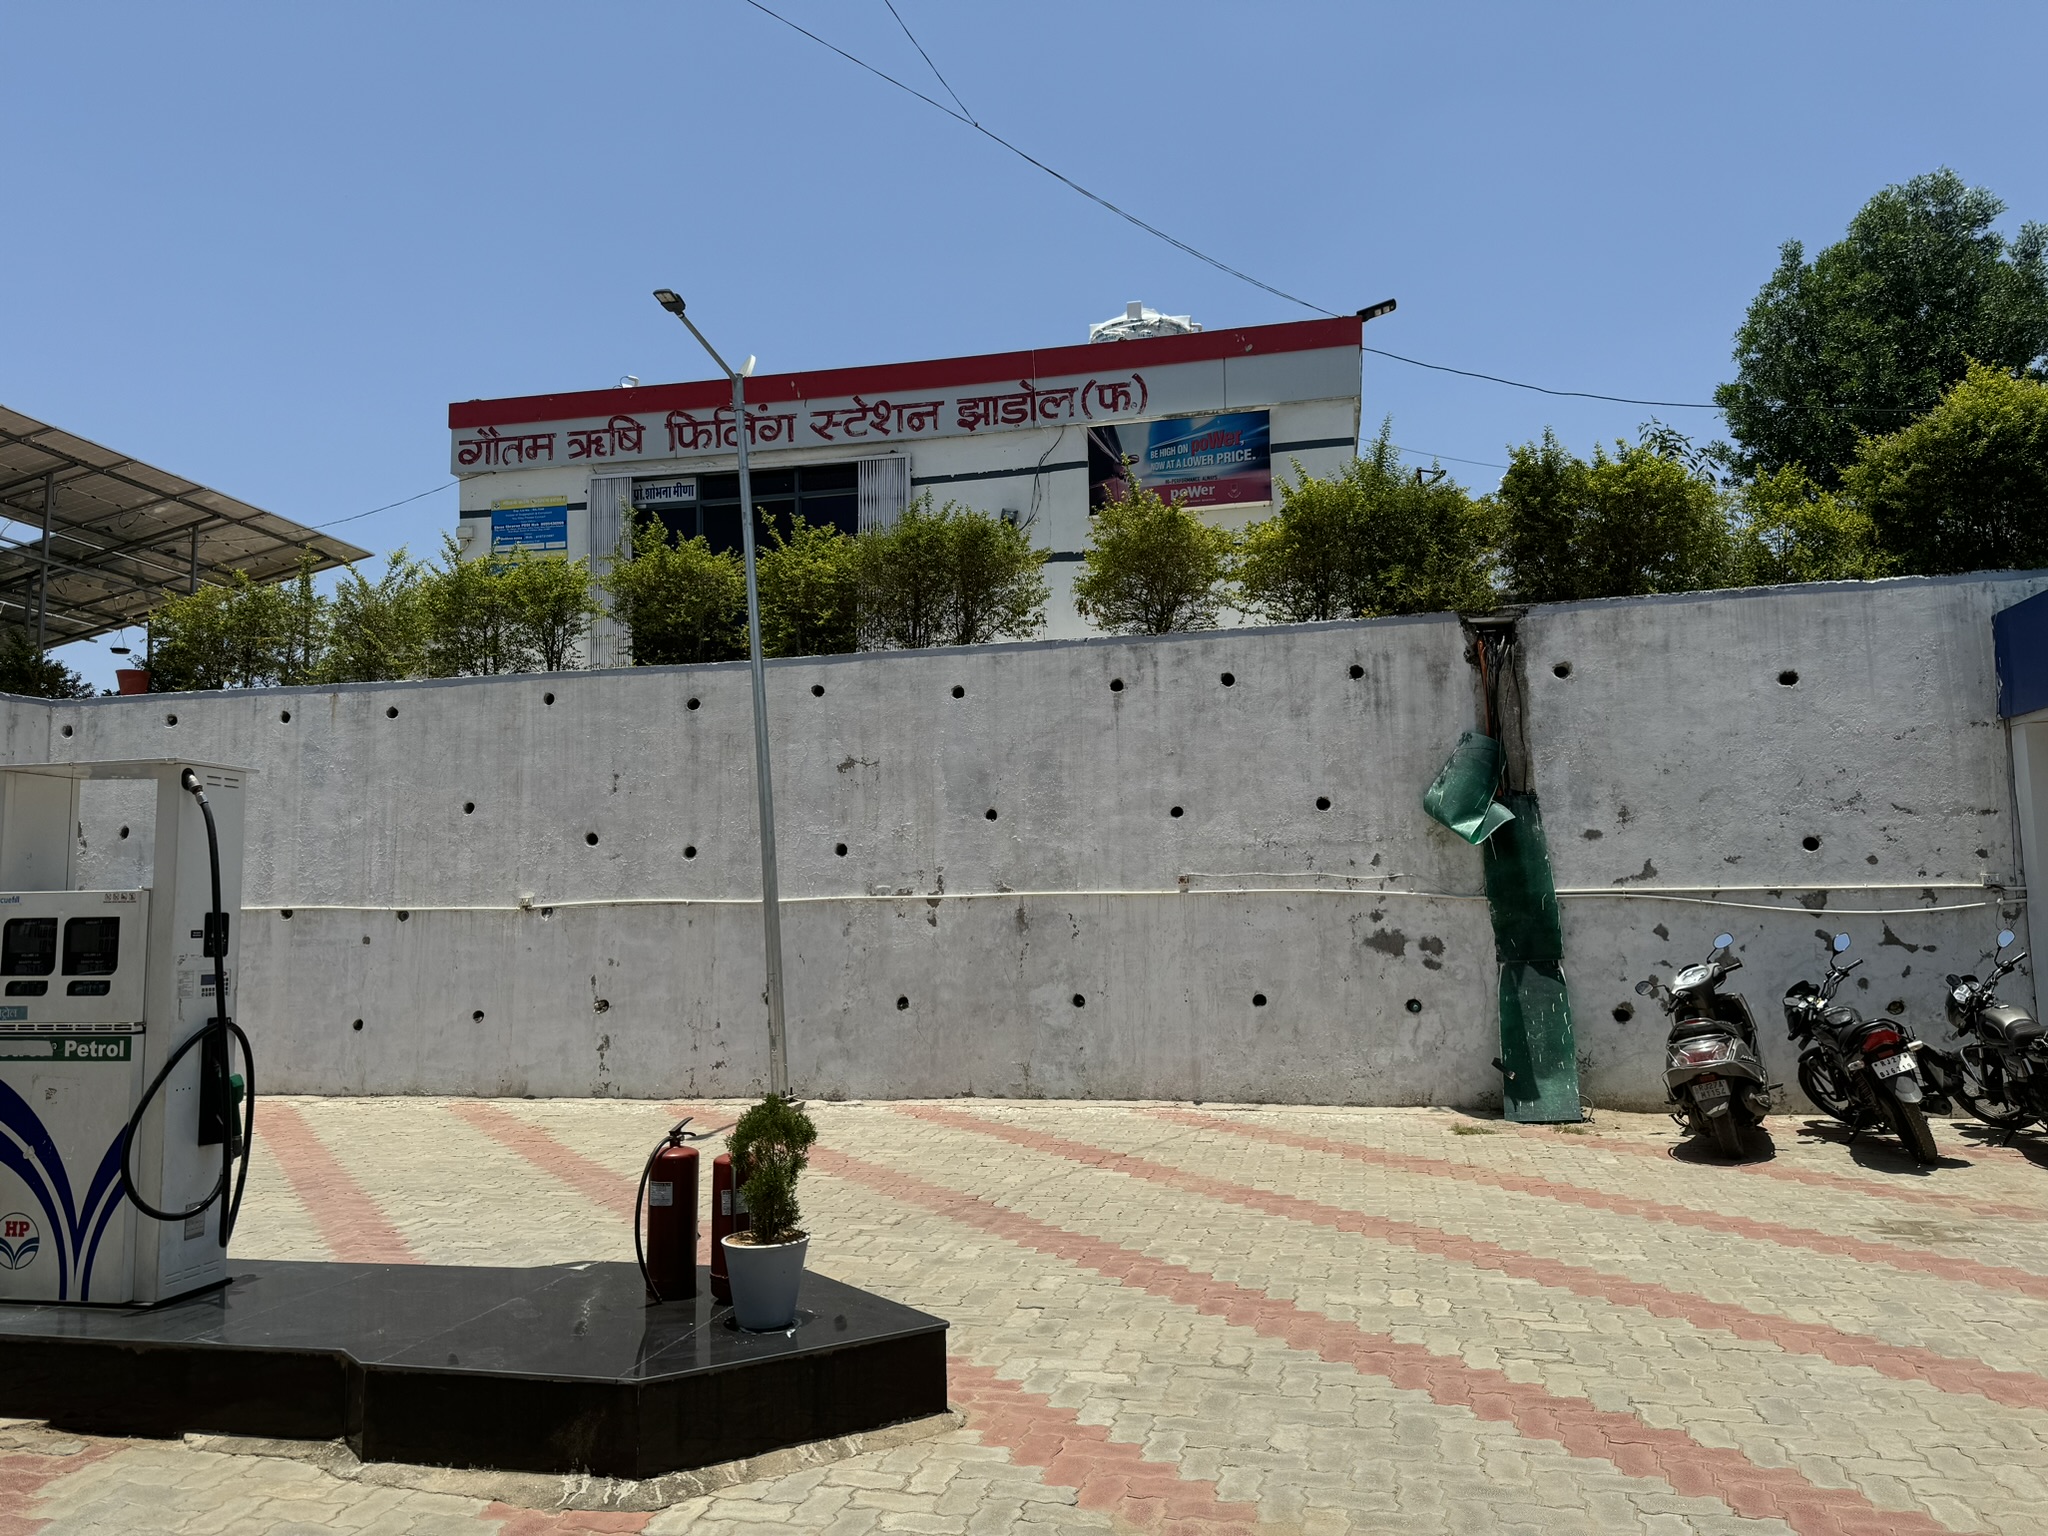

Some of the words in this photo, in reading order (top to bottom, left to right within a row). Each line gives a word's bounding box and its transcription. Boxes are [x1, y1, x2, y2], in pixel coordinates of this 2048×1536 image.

[458, 426, 557, 466] गौतम
[567, 415, 646, 460] ऋषि
[809, 395, 945, 441] स्टेशन
[1150, 450, 1159, 459] BE
[1160, 446, 1177, 458] HIGH
[1177, 443, 1189, 454] ON
[1151, 462, 1165, 471] NOW
[1166, 460, 1175, 470] AT
[1176, 459, 1182, 468] A
[1183, 454, 1214, 468] LOWER
[1216, 448, 1257, 465] PRICE.
[673, 482, 695, 497] मीणा
[64, 1040, 125, 1058] Petrol
[4, 1221, 30, 1237] HP
